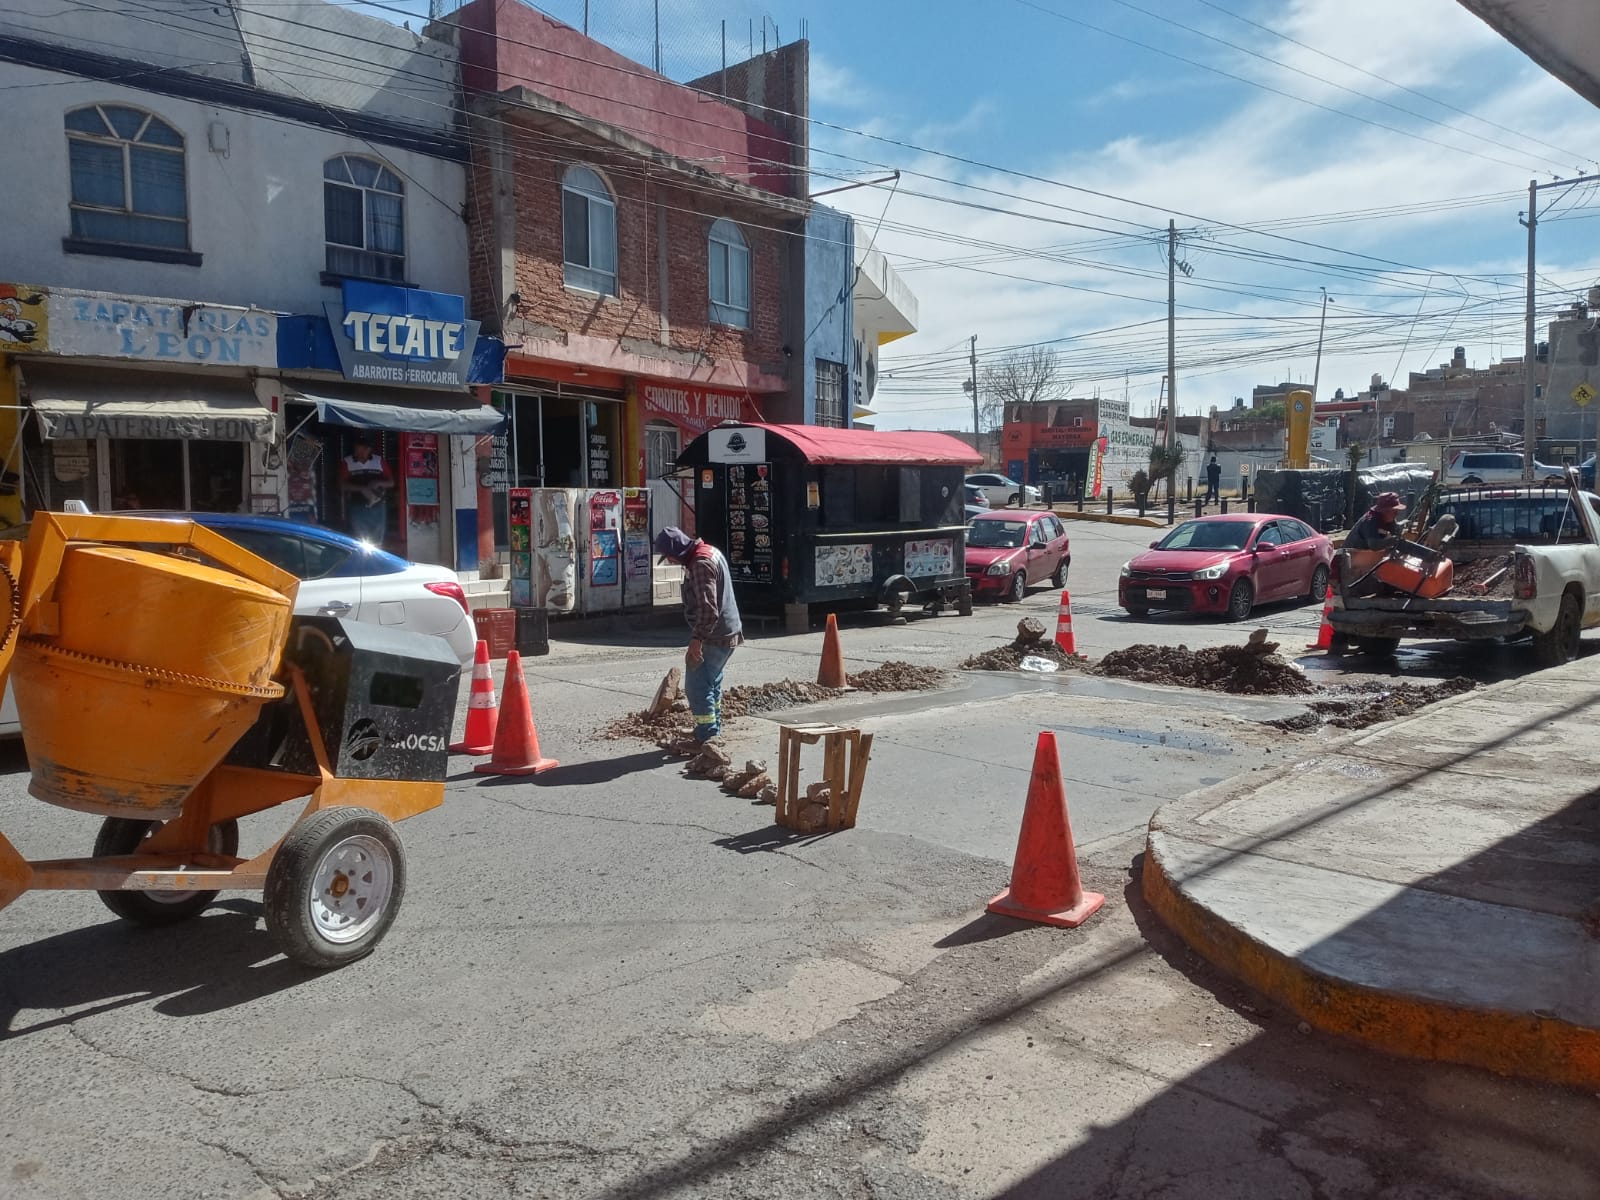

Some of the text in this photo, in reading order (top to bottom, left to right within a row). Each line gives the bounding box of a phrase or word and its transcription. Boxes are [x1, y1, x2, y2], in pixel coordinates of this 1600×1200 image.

[74, 299, 270, 337] ZAPATERIAS
[343, 311, 462, 359] TECATE
[352, 364, 460, 385] ABARROTES FERROCARRIL
[694, 392, 701, 416] Y
